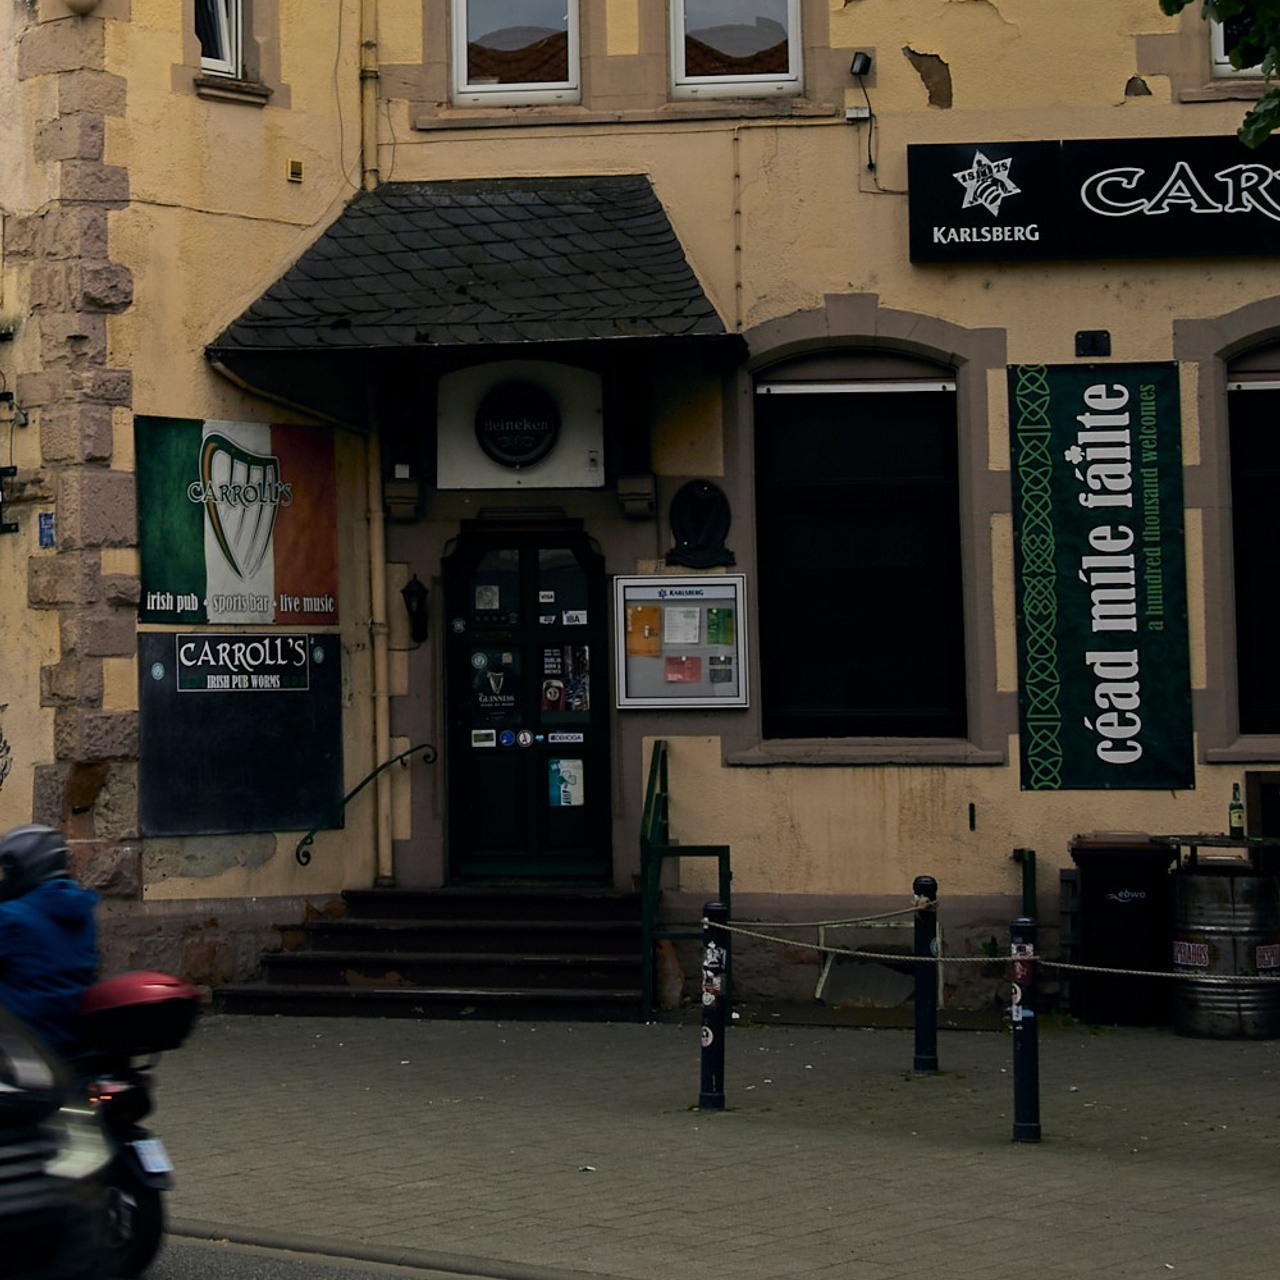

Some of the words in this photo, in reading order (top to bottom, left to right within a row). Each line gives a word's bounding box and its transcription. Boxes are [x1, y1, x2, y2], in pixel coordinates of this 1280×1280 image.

[1080, 161, 1280, 221] CAR
[932, 223, 1040, 244] KARLSBERG
[484, 418, 549, 433] Heineken
[1064, 383, 1133, 509] fáilte
[1138, 384, 1158, 463] welcomes
[1140, 466, 1162, 541] thousand
[1077, 524, 1137, 633] míle
[1143, 546, 1164, 616] hundred
[146, 591, 174, 611] irish
[176, 592, 199, 613] pub
[213, 594, 248, 614] sports
[250, 593, 269, 612] bar
[280, 594, 301, 612] live
[303, 593, 335, 613] music
[1147, 620, 1164, 631] a
[179, 637, 307, 672] CARROLL'S
[206, 674, 231, 689] IRISH
[232, 675, 249, 689] PUB
[251, 674, 281, 689] WORMS
[478, 694, 515, 703] GUINNESS
[1083, 648, 1143, 764] céad
